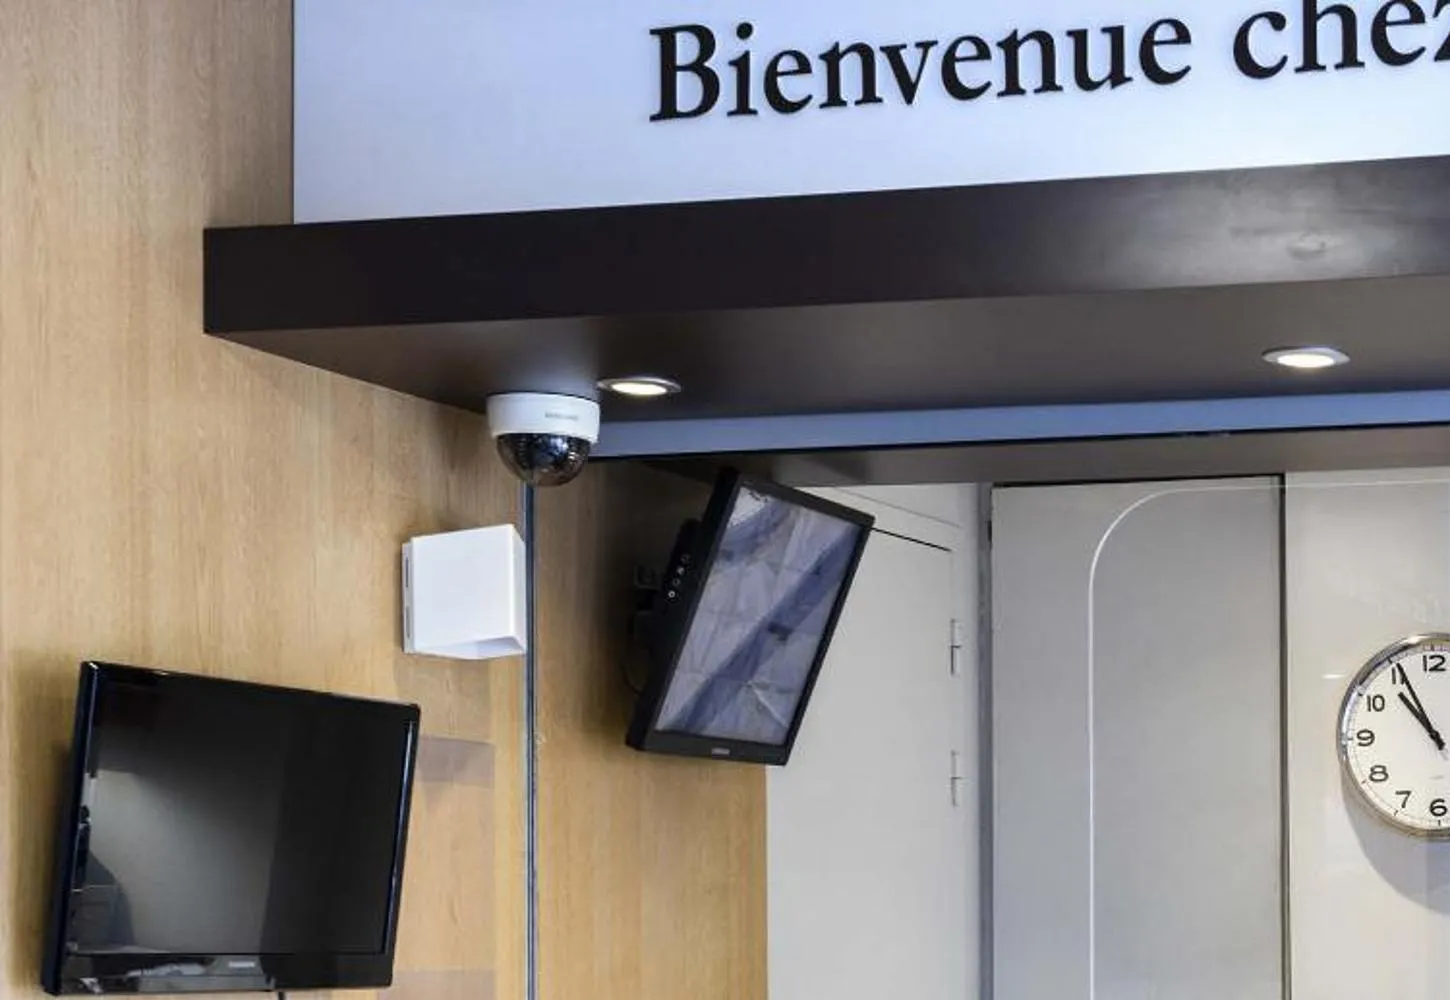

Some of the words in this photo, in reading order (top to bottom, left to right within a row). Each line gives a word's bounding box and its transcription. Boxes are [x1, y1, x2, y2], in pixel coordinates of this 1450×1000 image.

[649, 17, 1192, 122] Bienvenue
[1422, 654, 1446, 672] 12
[1366, 695, 1386, 713] 10
[1356, 729, 1375, 748] 9
[1369, 764, 1389, 783] 8
[1395, 790, 1413, 809] 7
[1428, 798, 1448, 817] 6
